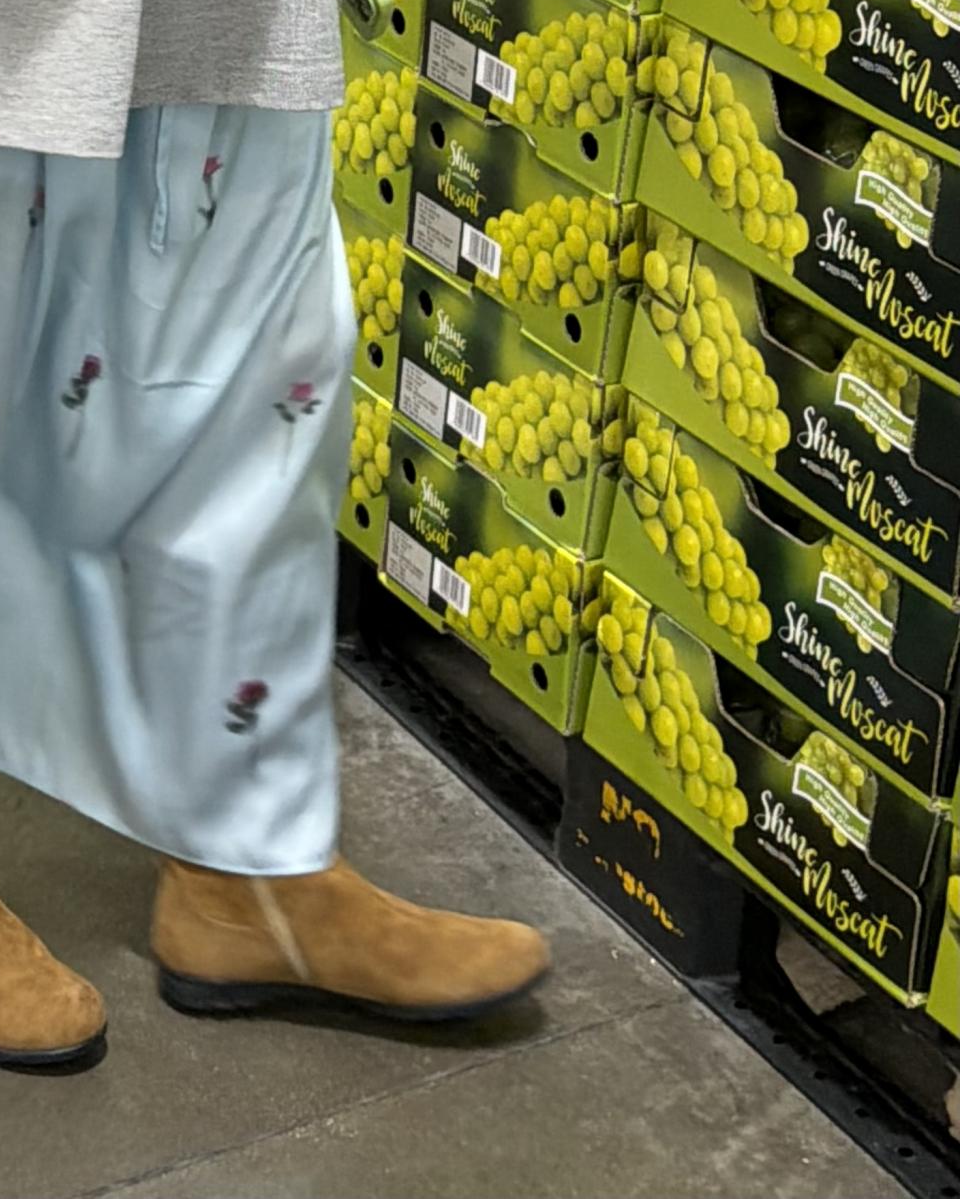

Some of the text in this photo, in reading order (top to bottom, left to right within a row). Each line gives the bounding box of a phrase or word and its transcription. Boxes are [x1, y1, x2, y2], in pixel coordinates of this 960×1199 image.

[849, 0, 917, 70] Shine
[448, 139, 480, 181] Shine
[815, 206, 881, 278] Shine
[435, 308, 467, 351] Shine
[797, 406, 861, 479] Shine
[778, 601, 843, 677] Shine
[754, 790, 818, 867] Shine
